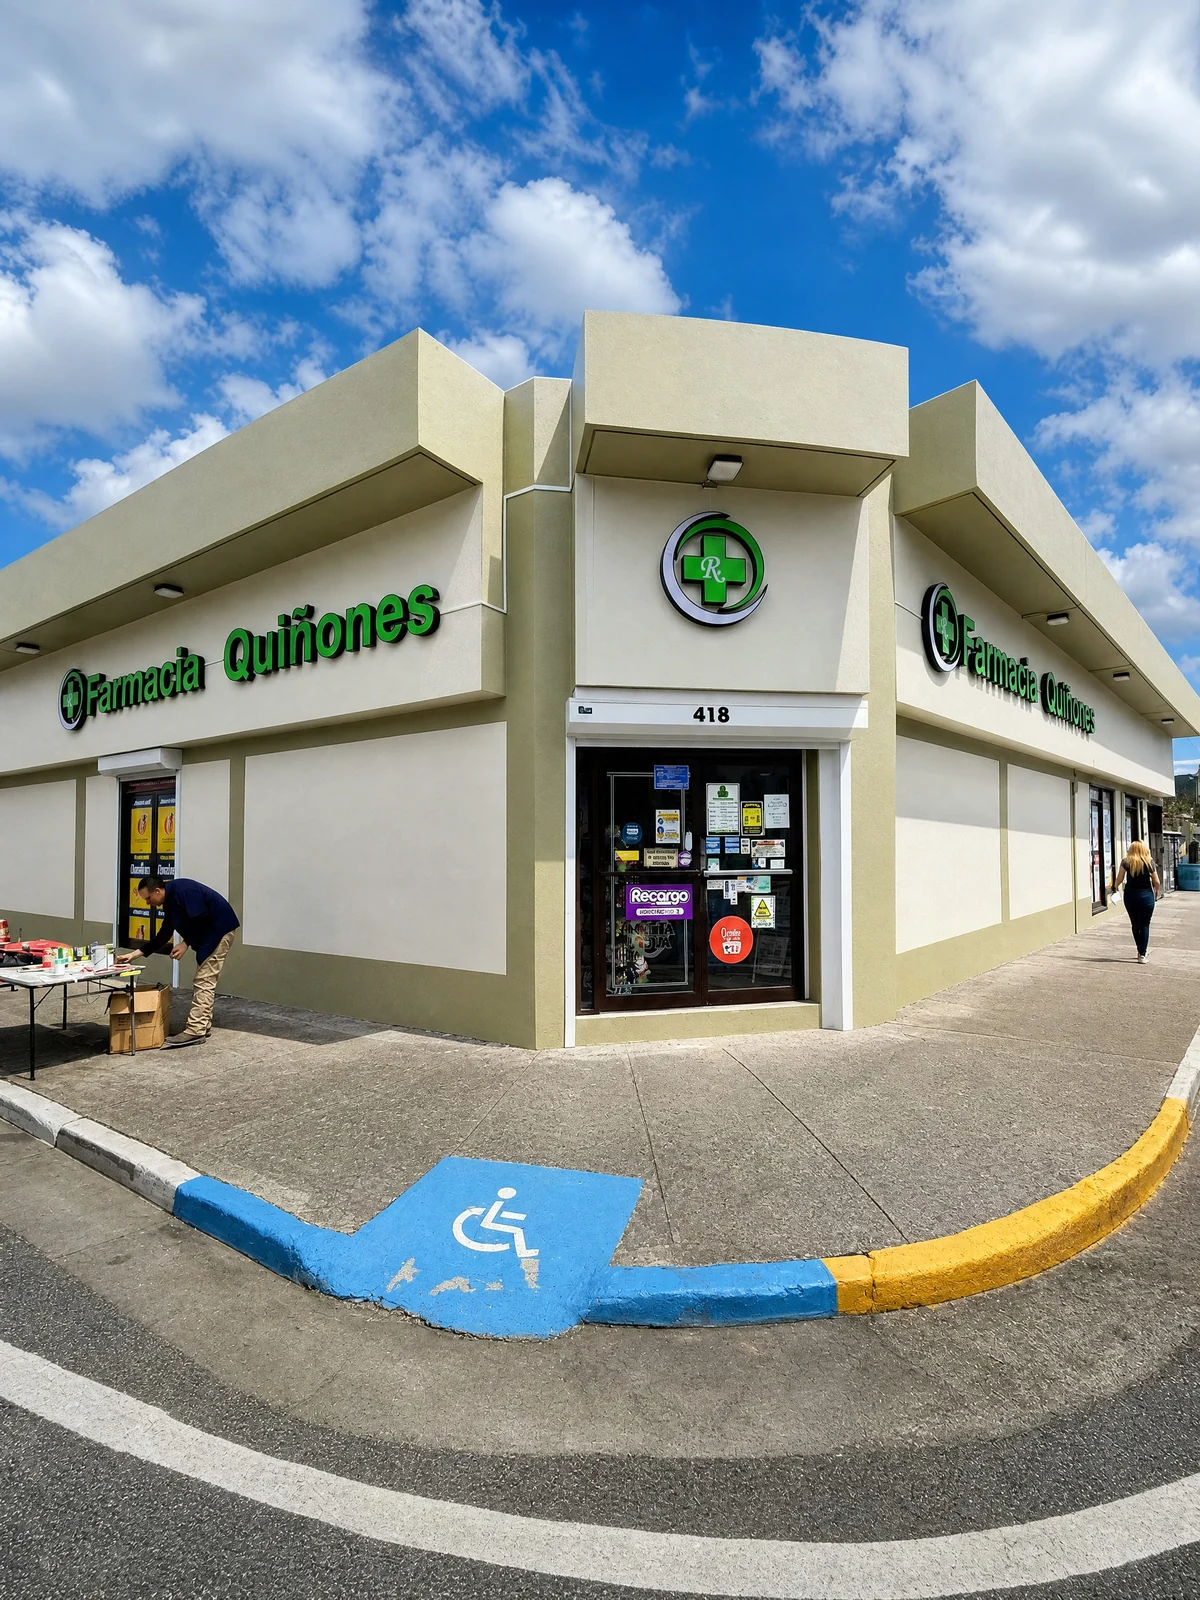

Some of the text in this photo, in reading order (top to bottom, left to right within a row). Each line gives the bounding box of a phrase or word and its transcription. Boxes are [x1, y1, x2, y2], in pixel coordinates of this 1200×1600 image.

[86, 647, 205, 715] Farmacia
[223, 584, 441, 682] Quiñones
[958, 613, 1096, 734] Farmacia Quiñones
[693, 706, 730, 723] 418
[631, 888, 690, 905] Recargo
